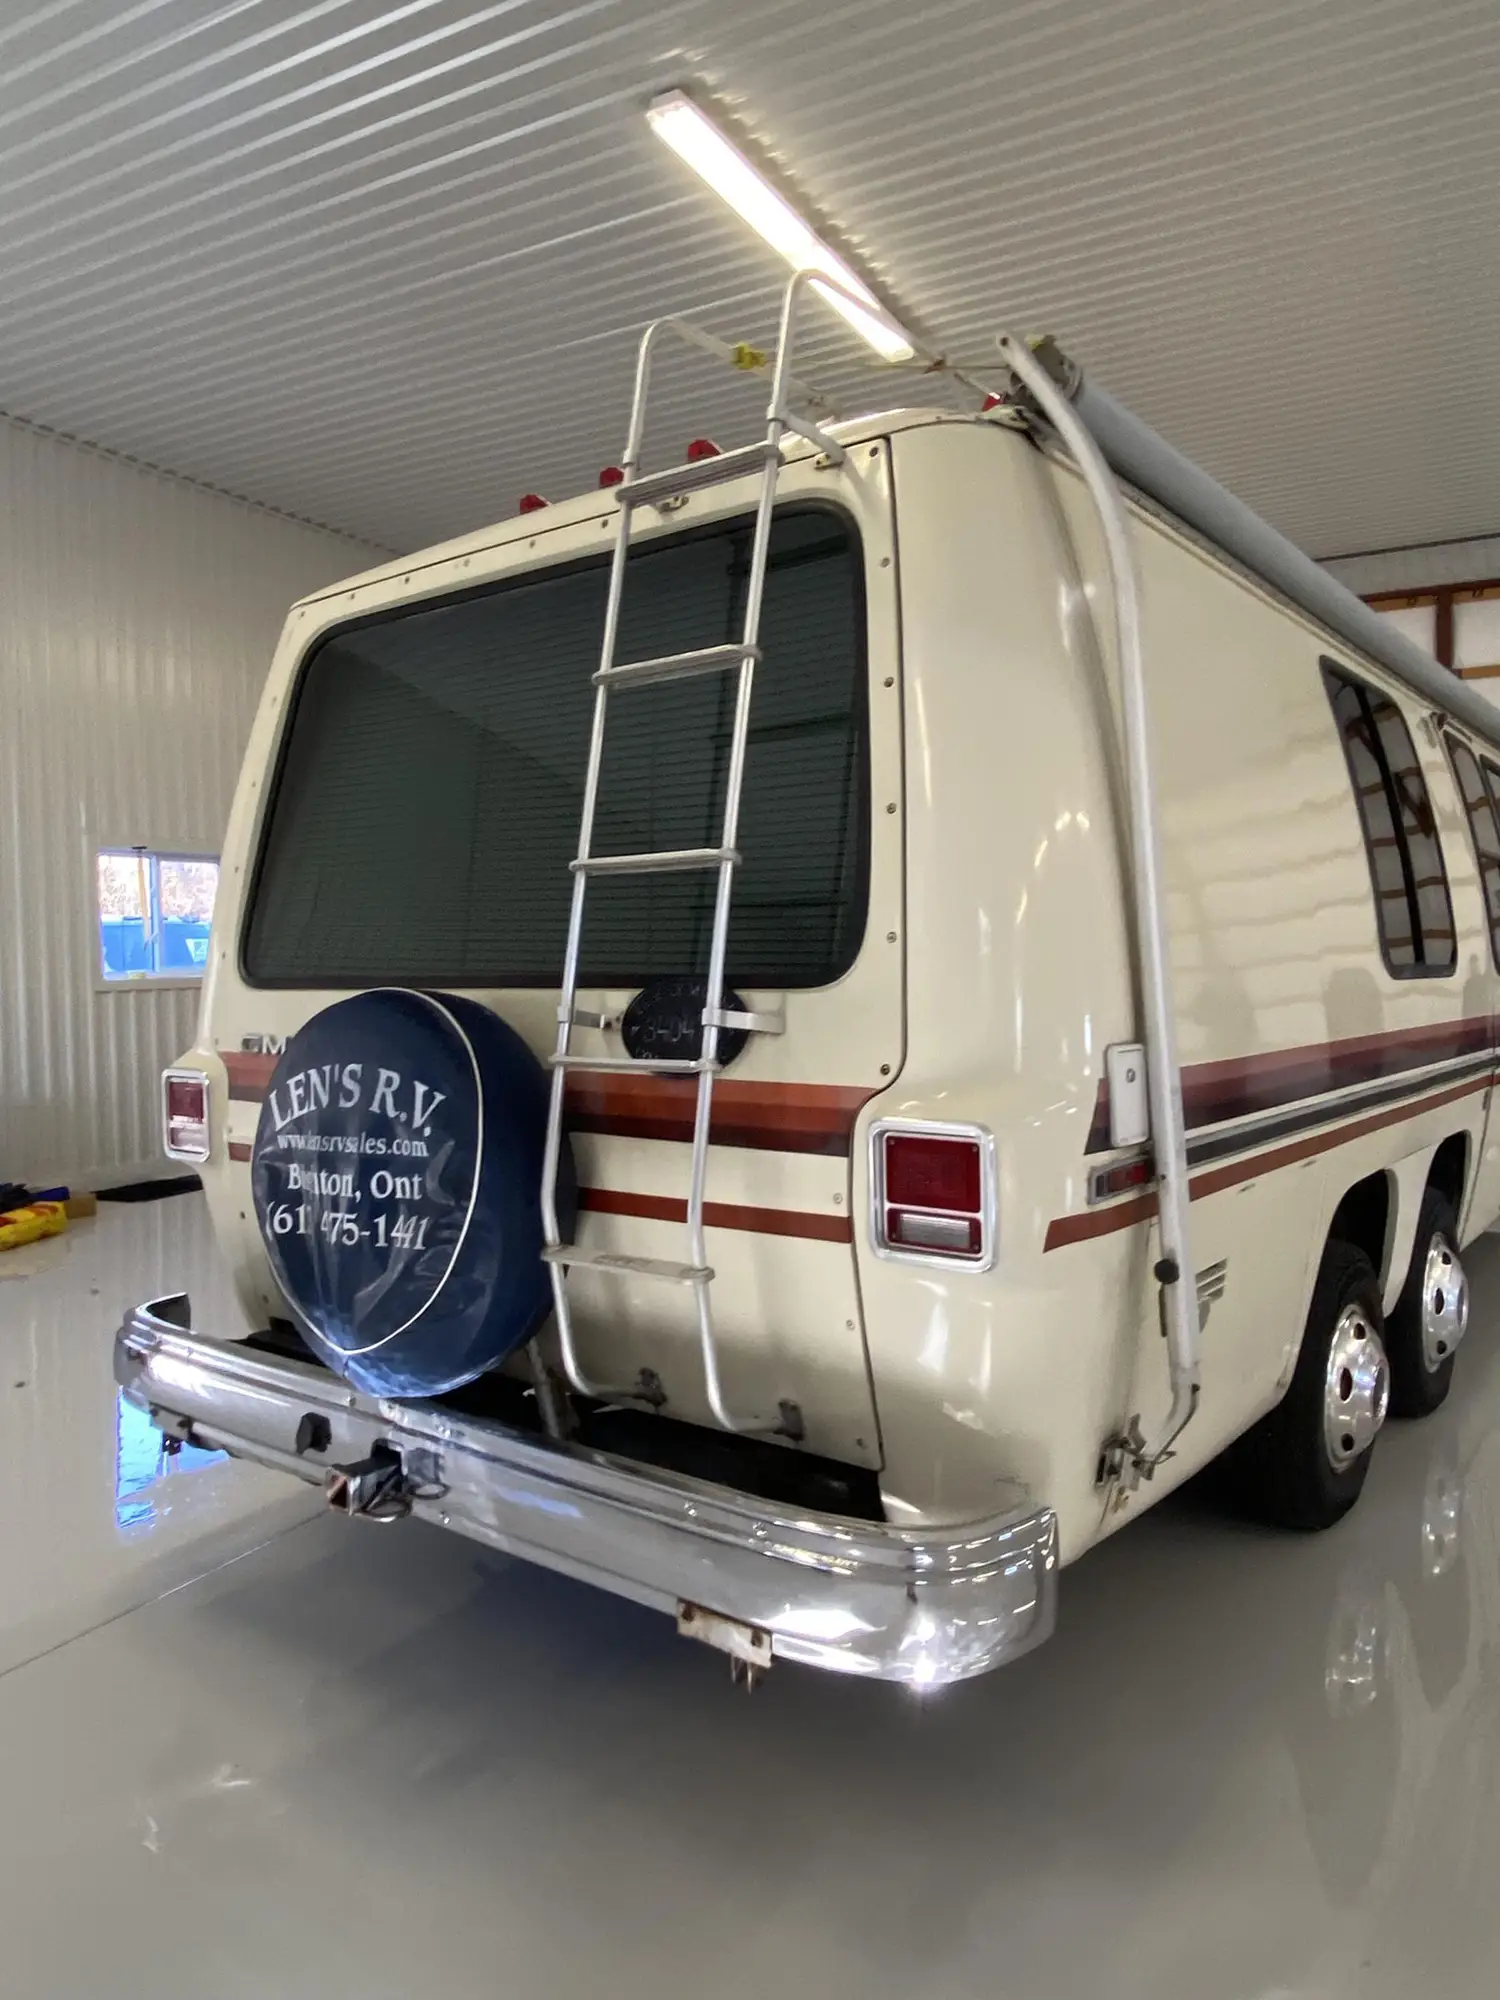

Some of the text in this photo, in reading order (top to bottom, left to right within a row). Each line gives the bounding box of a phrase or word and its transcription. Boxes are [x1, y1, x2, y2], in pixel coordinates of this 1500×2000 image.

[240, 1033, 290, 1055] GM
[268, 1063, 448, 1138] LEN'S R.V.
[370, 1170, 423, 1201] Ont
